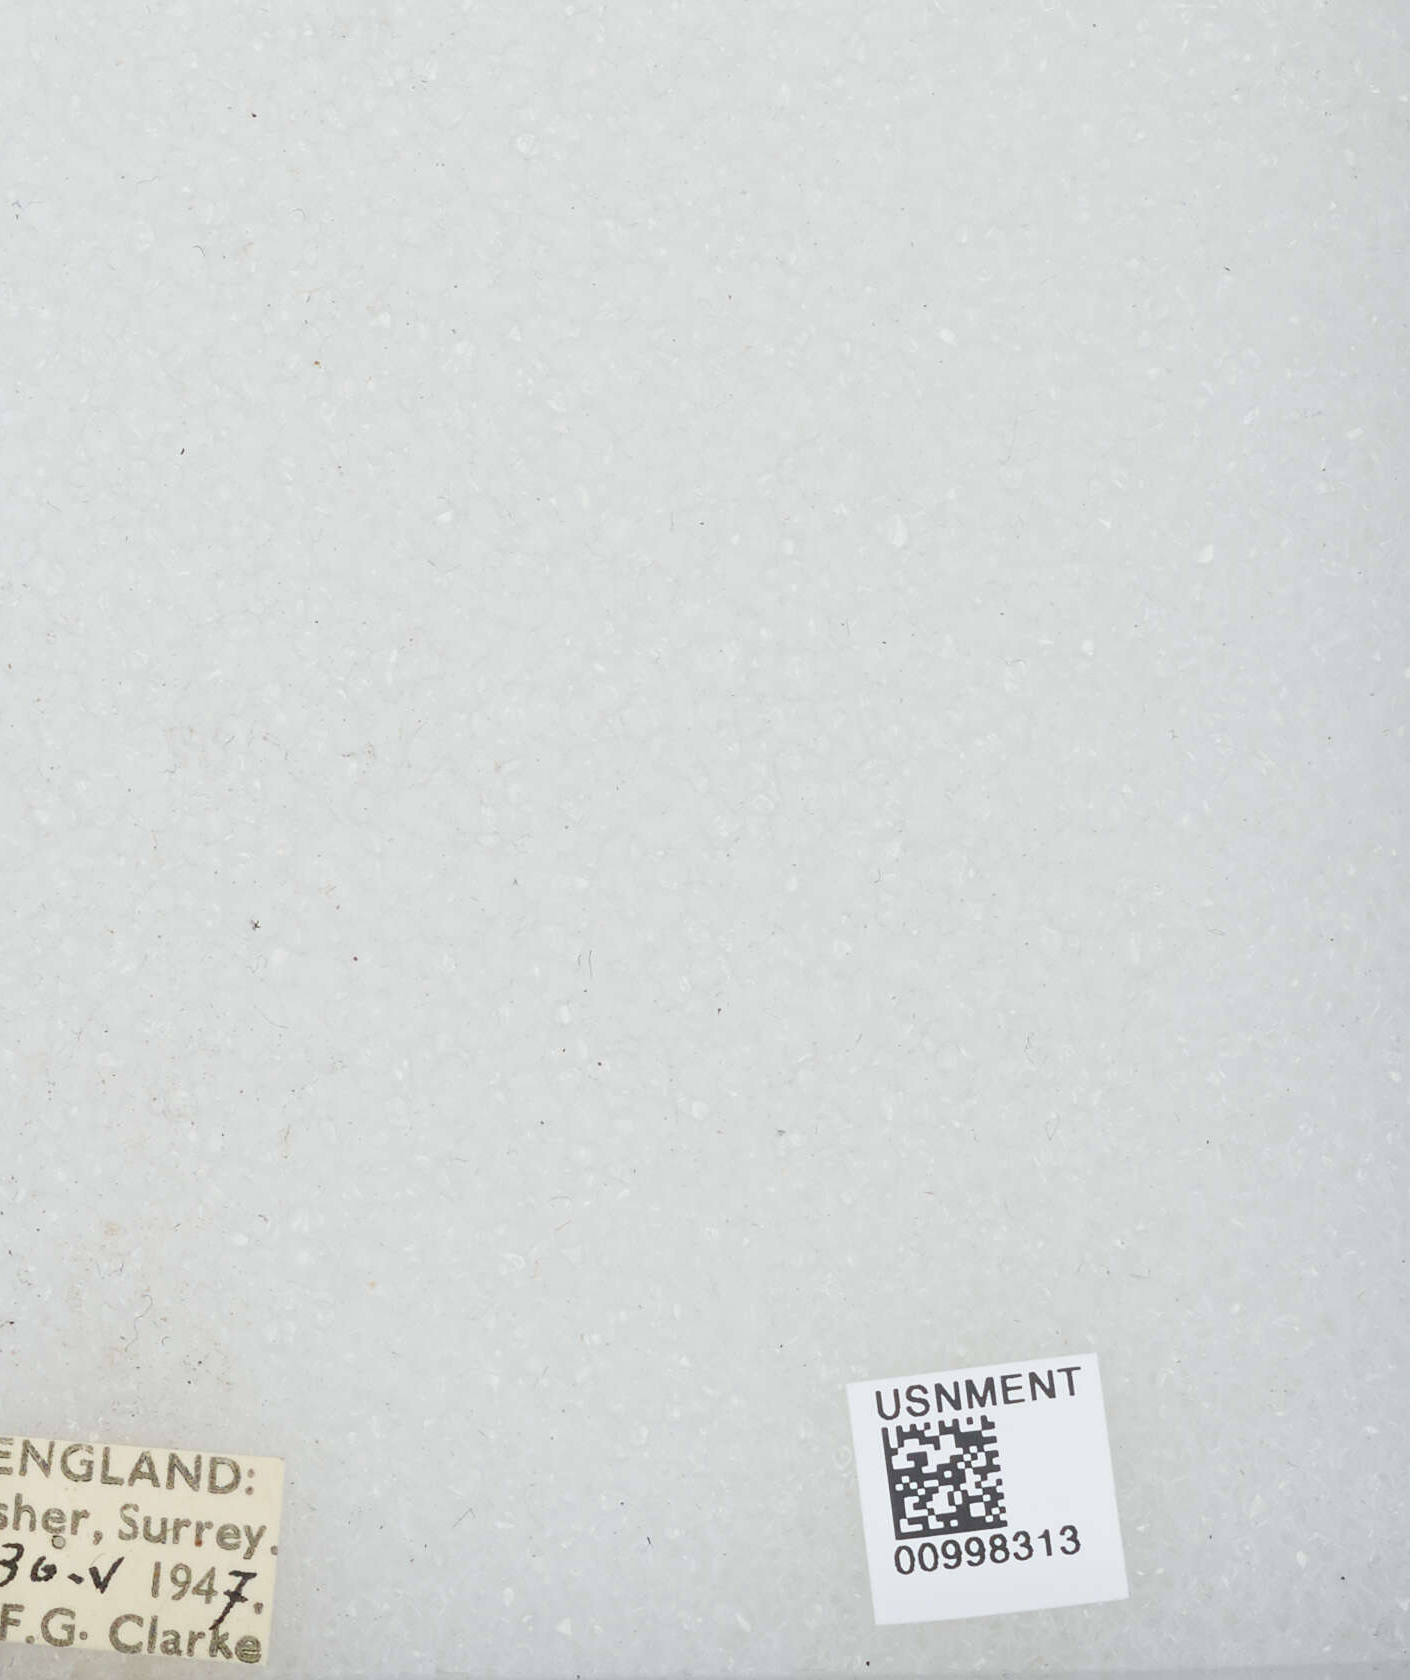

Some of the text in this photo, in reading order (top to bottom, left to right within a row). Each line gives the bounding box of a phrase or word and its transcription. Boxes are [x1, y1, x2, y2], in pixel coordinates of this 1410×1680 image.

[875, 1366, 1081, 1421] USNMENT
[117, 1503, 279, 1560] Surrey.
[894, 1525, 1081, 1576] 00998313
[108, 1613, 263, 1664] Clarke
